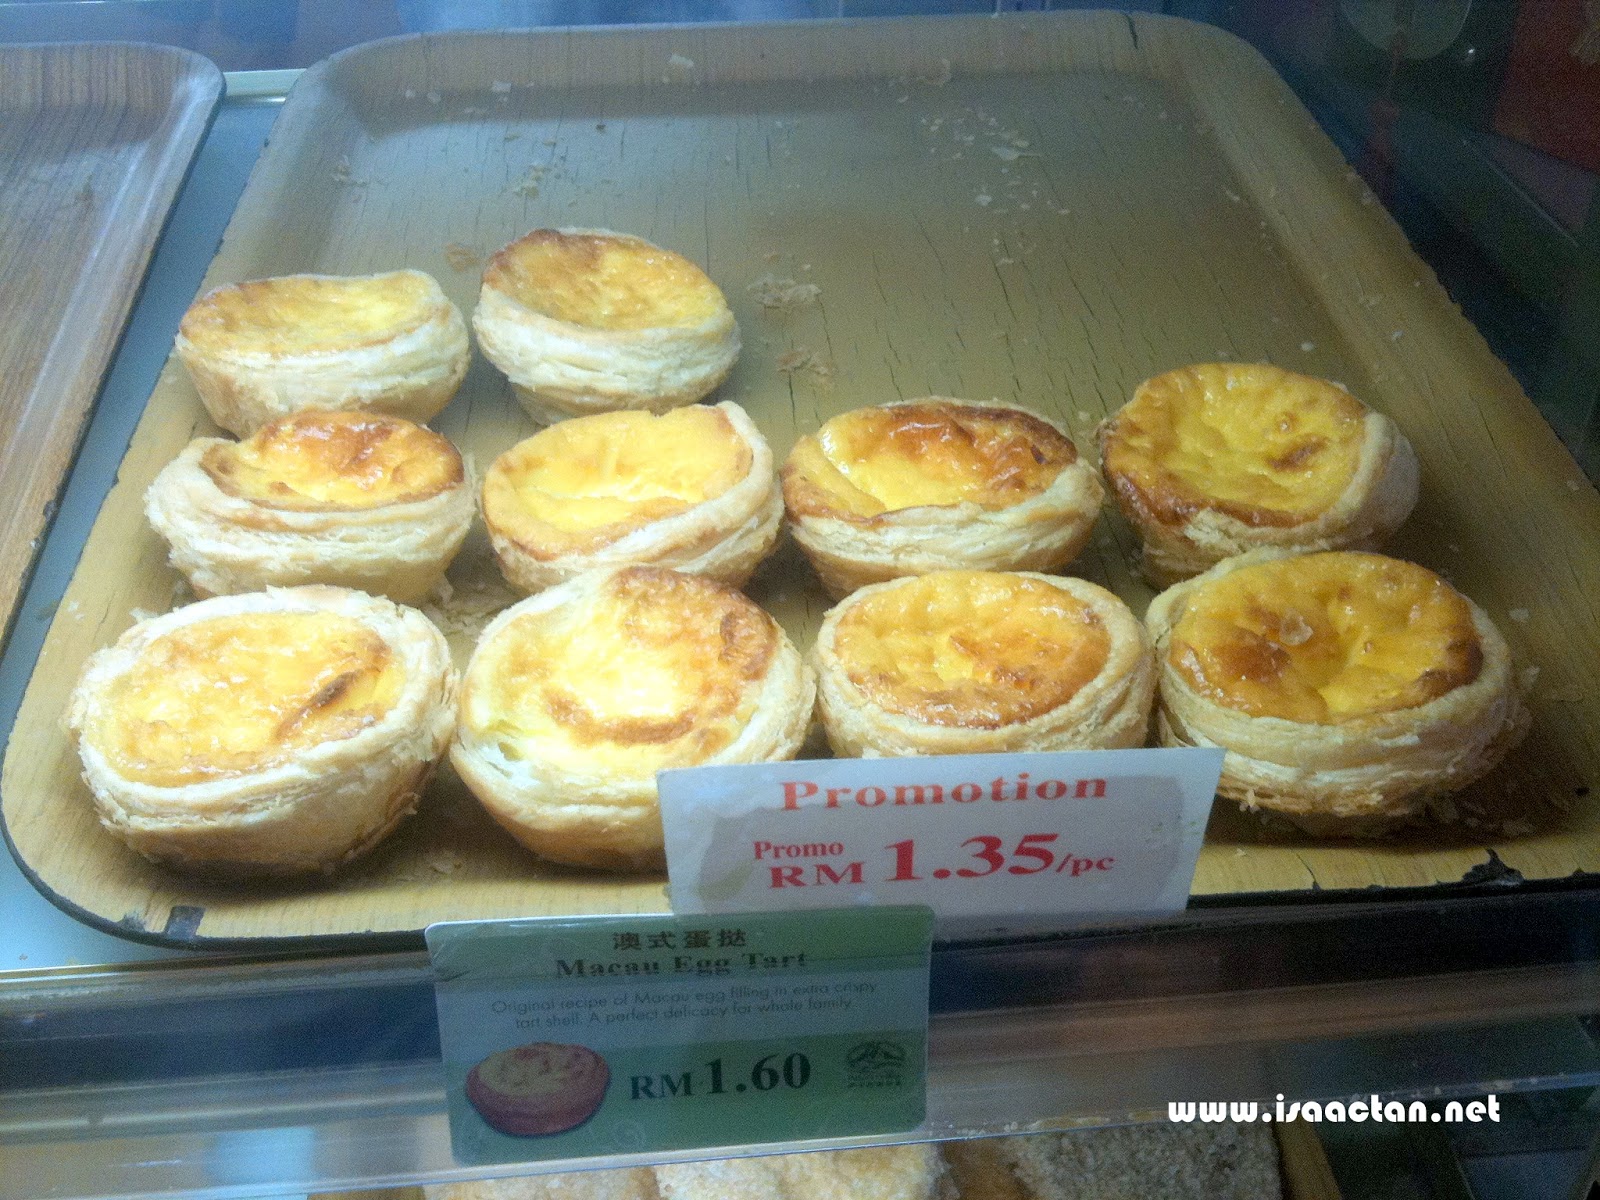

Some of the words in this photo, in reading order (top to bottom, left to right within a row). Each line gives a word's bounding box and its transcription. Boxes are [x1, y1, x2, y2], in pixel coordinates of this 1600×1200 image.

[780, 772, 1107, 812] Promotion
[754, 839, 844, 862] Promo
[769, 861, 864, 889] RM
[884, 832, 1116, 882] 1.35/pc
[555, 958, 660, 978] Macau
[673, 955, 731, 977] Egg
[741, 951, 807, 970] Tart
[491, 997, 554, 1015] Original
[560, 996, 607, 1012] recipe
[612, 992, 629, 1006] of
[634, 992, 690, 1005] Macau
[695, 990, 726, 1004] egg
[731, 985, 769, 1000] filling
[774, 985, 788, 997] in
[793, 983, 829, 996] extra
[833, 981, 877, 995] crispy
[515, 1016, 541, 1030] tart
[589, 1011, 601, 1024] A
[606, 1007, 658, 1025] perfect
[663, 1003, 729, 1020] delicacy
[732, 1001, 751, 1014] for
[759, 998, 804, 1013] whole
[630, 1072, 693, 1101] RM
[706, 1052, 812, 1095] 1.60
